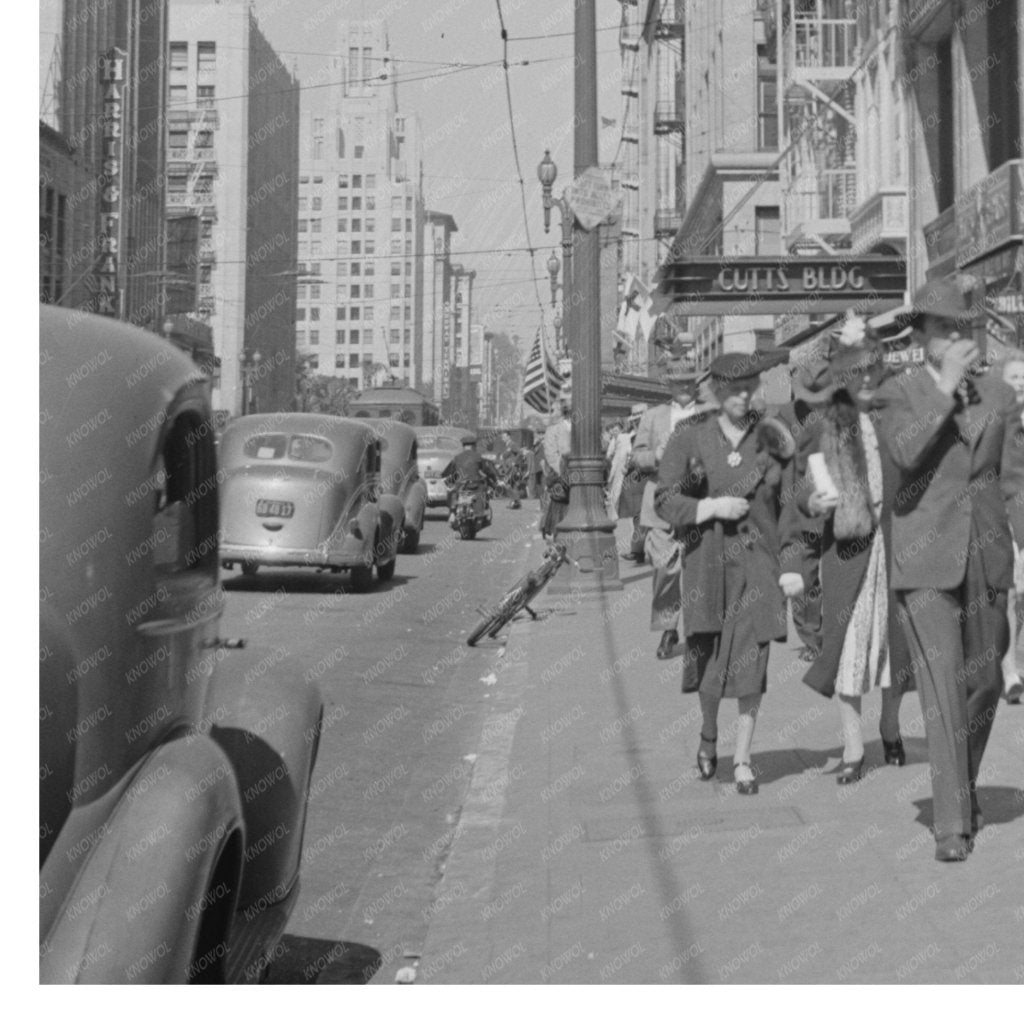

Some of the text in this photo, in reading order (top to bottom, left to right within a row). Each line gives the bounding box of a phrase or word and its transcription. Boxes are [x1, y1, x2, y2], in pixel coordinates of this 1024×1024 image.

[102, 58, 124, 177] HARRIS
[717, 264, 865, 292] CUTTS BLDG
